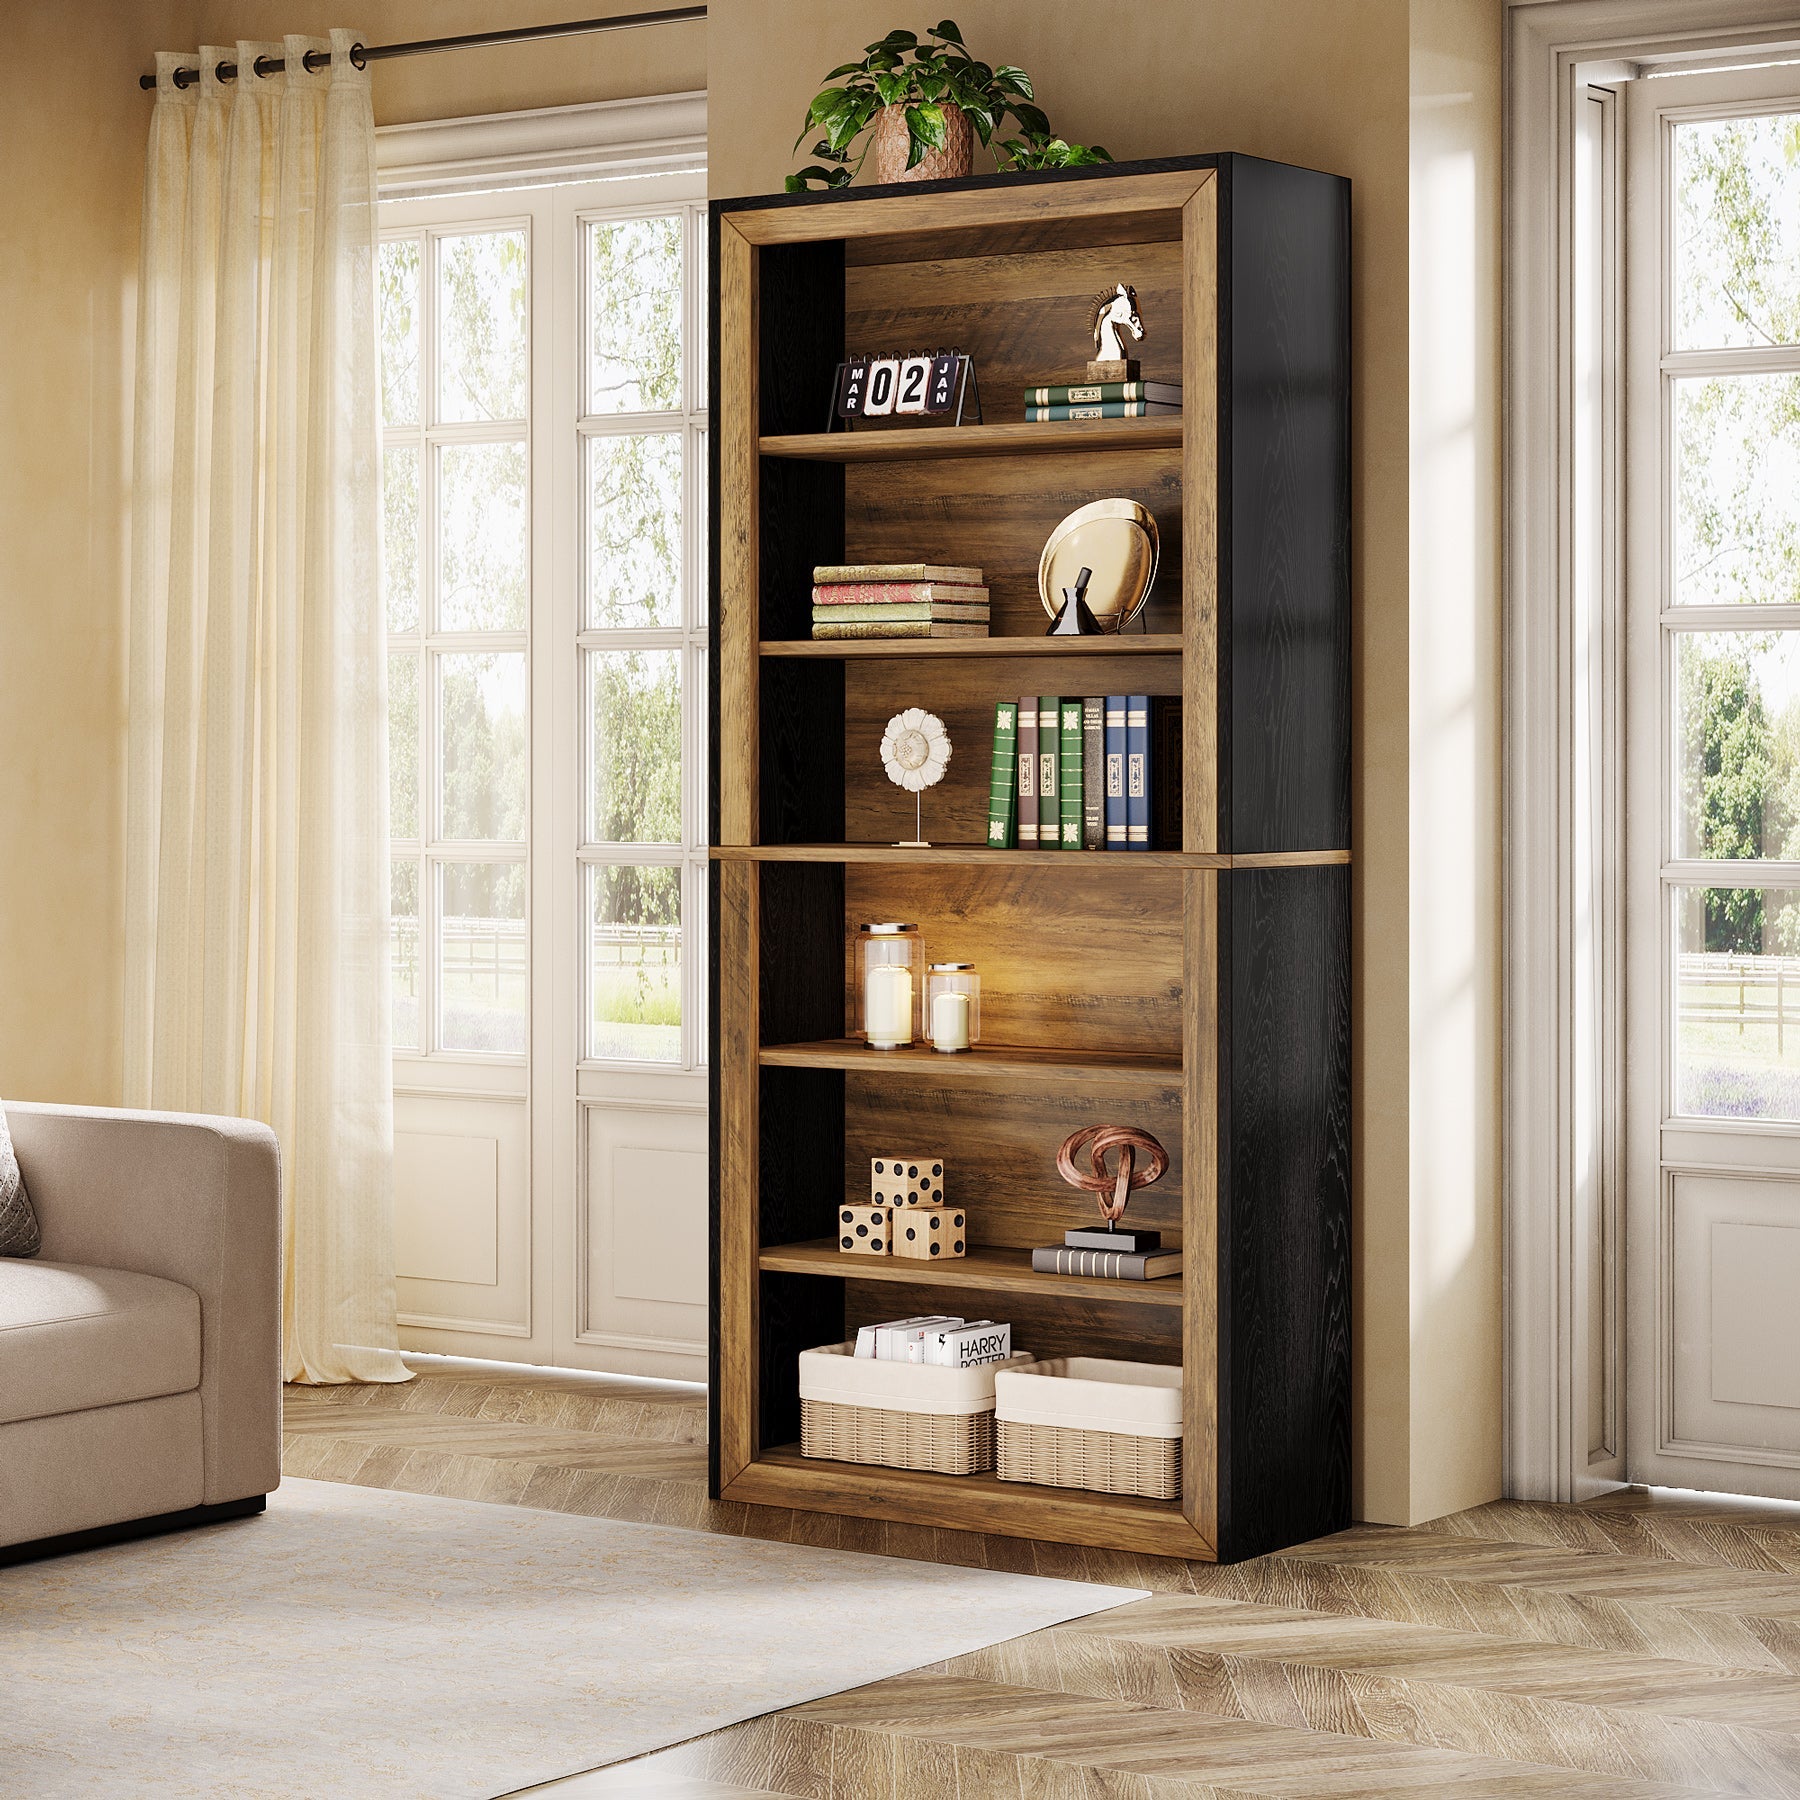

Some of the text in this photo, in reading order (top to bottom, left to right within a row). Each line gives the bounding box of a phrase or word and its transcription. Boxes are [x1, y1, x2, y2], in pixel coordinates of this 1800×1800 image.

[846, 368, 864, 409] MAR
[871, 365, 924, 406] 02
[936, 362, 949, 404] JAN
[960, 1333, 1006, 1359] HARRY
